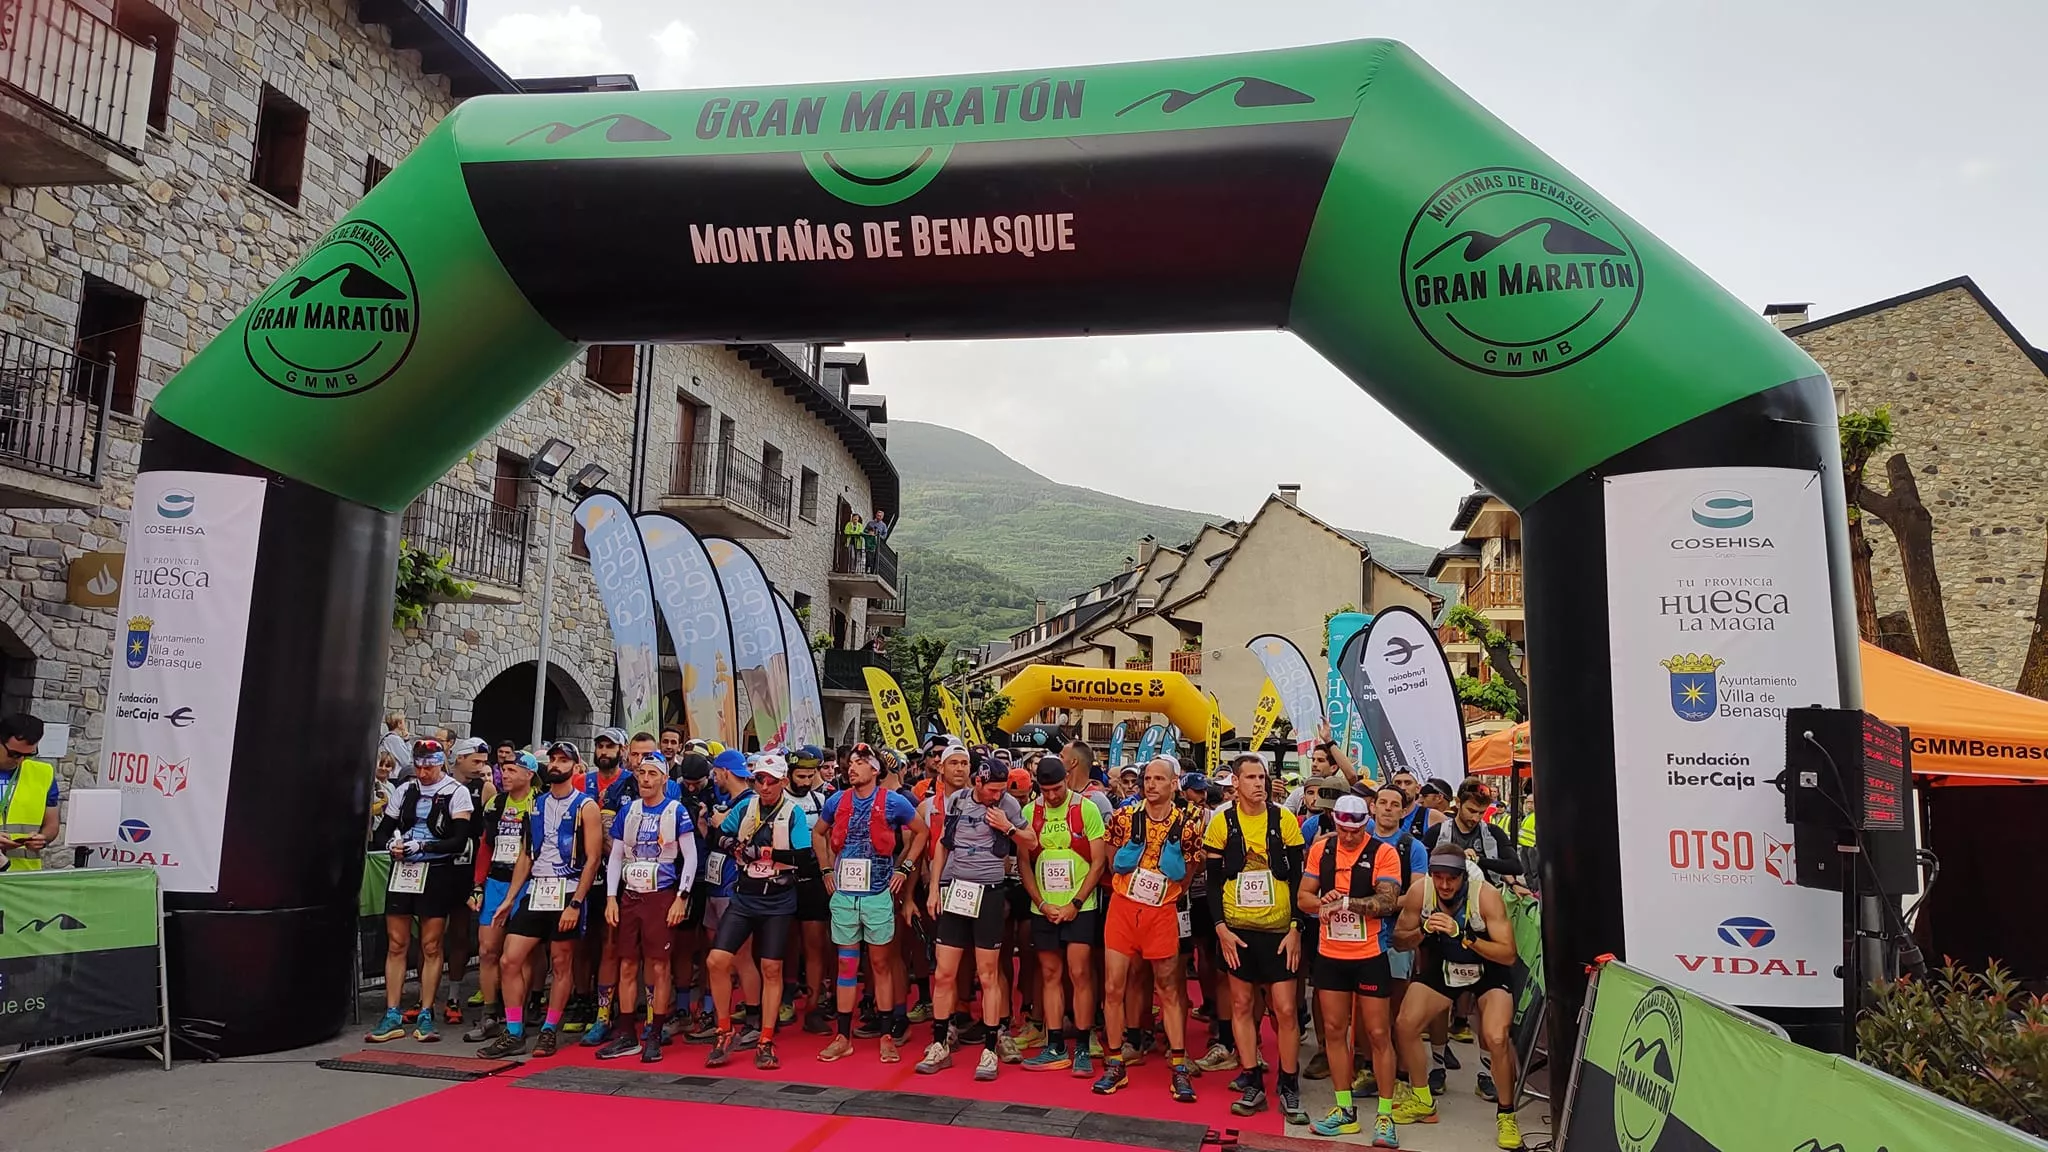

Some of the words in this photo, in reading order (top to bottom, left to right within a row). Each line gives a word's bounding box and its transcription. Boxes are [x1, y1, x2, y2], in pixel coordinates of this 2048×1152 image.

[695, 95, 827, 141] GRAN
[840, 77, 1086, 133] MARATÓN
[1426, 174, 1503, 222] MONTAÑAS
[1507, 174, 1526, 189] DE
[1530, 174, 1601, 222] BENASQUE
[350, 225, 395, 262] BENASQUE
[688, 219, 854, 264] MONTAÑAS
[862, 220, 903, 258] DE
[909, 213, 1076, 258] BENASQUE
[1414, 270, 1488, 308] GRAN
[1498, 258, 1635, 296] MARATÓN
[252, 306, 299, 331] GRAN
[304, 303, 410, 333] MARATÓN
[1483, 340, 1573, 366] GMMB
[285, 370, 359, 390] GMMB
[144, 525, 206, 536] COSEHISA
[1670, 537, 1775, 550] COSEHISA
[150, 633, 205, 645] Ayuntamiento
[149, 644, 169, 656] Villa
[173, 648, 185, 657] de
[147, 656, 203, 670] Benasque
[1051, 674, 1144, 696] barrabes
[1719, 675, 1797, 688] Ayuntamiento
[118, 692, 158, 704] Fundación
[1069, 695, 1141, 704] www.barrabes.com
[1719, 689, 1754, 703] Villa
[1760, 692, 1775, 703] de
[116, 706, 159, 723] iberCaja
[1666, 752, 1750, 766] Fundación
[108, 752, 150, 784] OTSO
[1667, 771, 1755, 790] iberCaja
[121, 786, 146, 795] SPORT
[499, 843, 516, 853] 179
[1669, 829, 1754, 871] OTSO
[98, 846, 179, 867] VIDAL
[401, 868, 418, 878] 563
[630, 869, 649, 878] 486
[845, 867, 862, 876] 132
[1047, 868, 1066, 877] 352
[1672, 872, 1711, 884] THINK
[1713, 874, 1756, 885] SPORT
[540, 886, 557, 895] 147
[1138, 878, 1160, 892] 538
[1243, 880, 1265, 891] 367
[955, 888, 974, 900] 639
[1334, 912, 1356, 924] 366
[1452, 968, 1474, 977] 465
[1675, 954, 1818, 977] VIDAL
[1617, 1060, 1637, 1093] GRAN
[1635, 1070, 1672, 1115] MARATÓN
